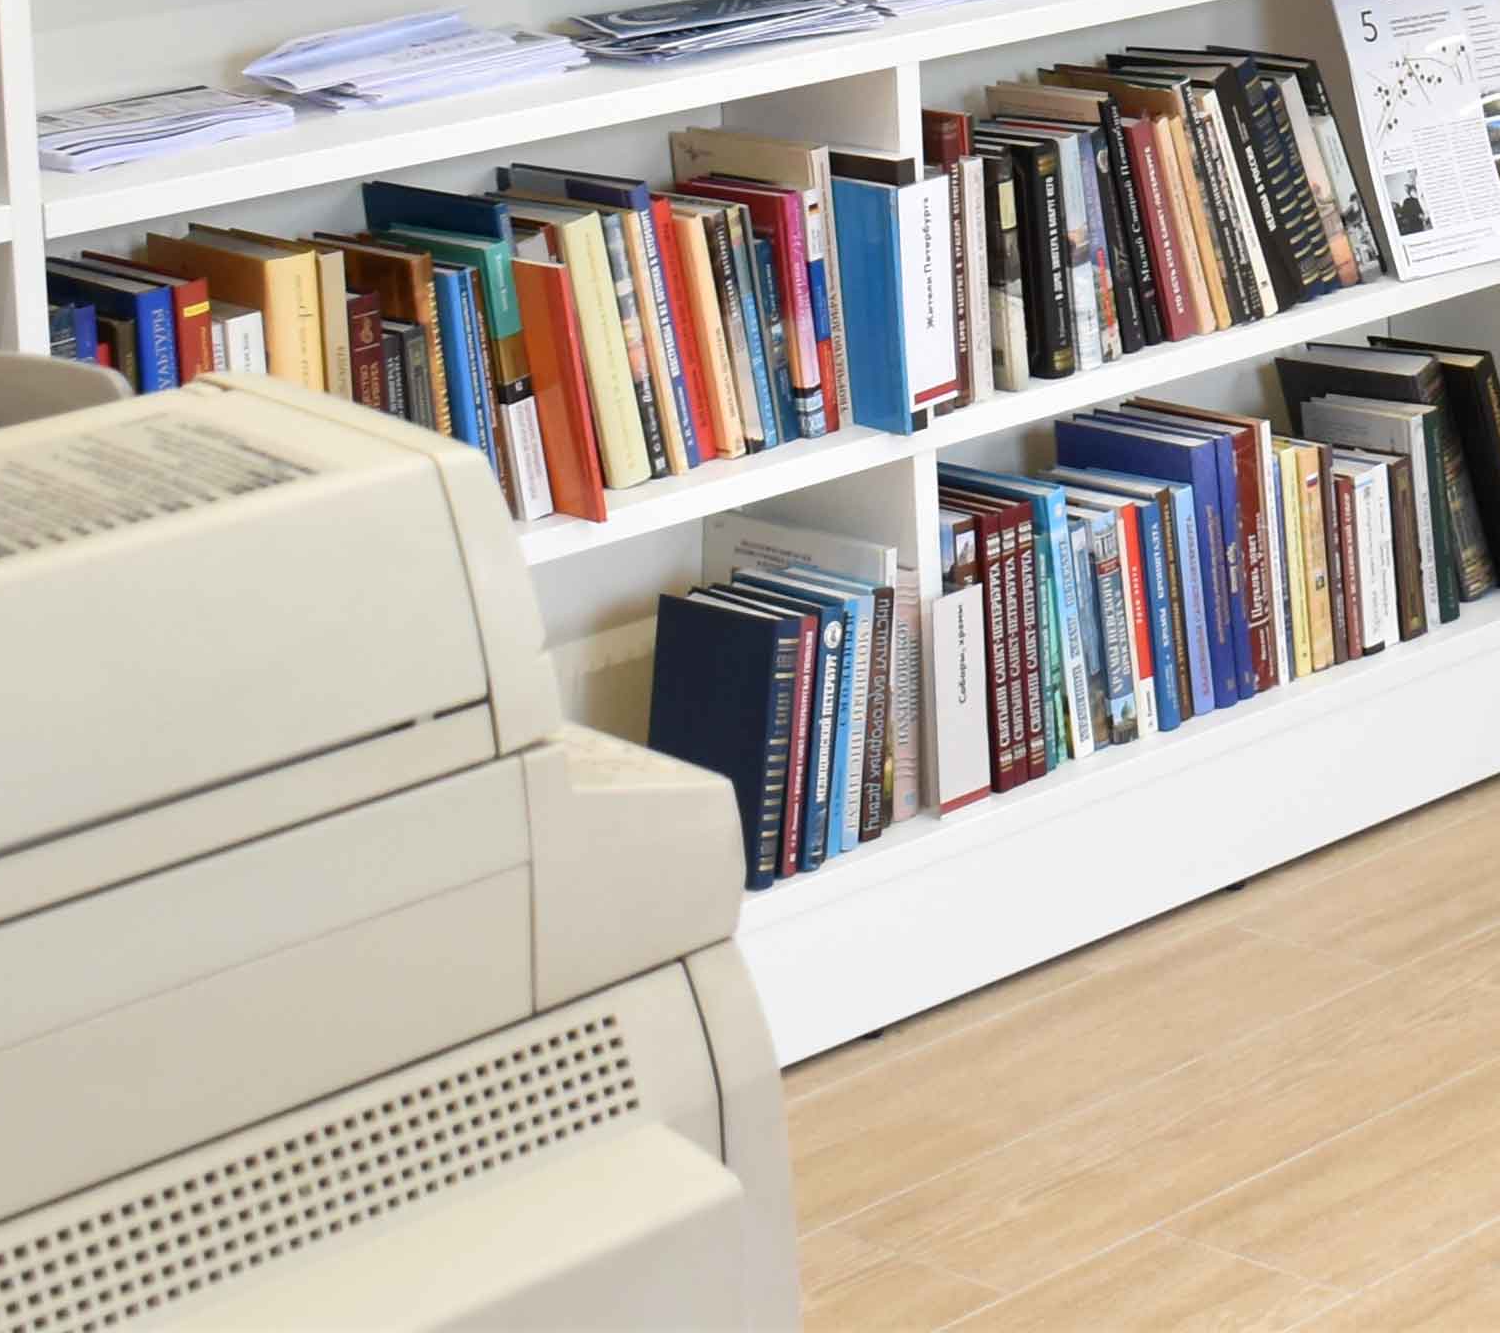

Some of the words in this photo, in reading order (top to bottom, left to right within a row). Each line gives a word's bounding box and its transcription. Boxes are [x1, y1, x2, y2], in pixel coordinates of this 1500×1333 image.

[1360, 10, 1379, 43] 5
[1137, 144, 1172, 239] САНКТ-ПЕТЕРБУРГЕ
[1243, 143, 1263, 184] РОССИИ
[921, 195, 933, 273] Петербурга
[1120, 178, 1143, 234] Старый
[1132, 235, 1153, 283] Милый
[1161, 246, 1179, 269] КТО
[1166, 267, 1185, 294] ЕСТЬ
[922, 275, 934, 328] Жители
[1172, 293, 1190, 314] КТО
[950, 603, 967, 646] храмы
[988, 560, 1008, 683] САНКТ-ПЕТЕРБУРГА
[1002, 554, 1022, 677] САНКТ-ПЕТЕРБУРГА
[1019, 548, 1040, 670] САНКТ-ПЕТЕРБУРГА
[821, 652, 838, 716] ПЕТЕРБУРГ
[1010, 680, 1026, 740] СВЯТЫНИ
[1026, 672, 1044, 732] СВЯТЫНИ
[995, 686, 1012, 746] СВЯТЫНИ
[815, 716, 834, 804] МЕДИЦИНСКИЙ
